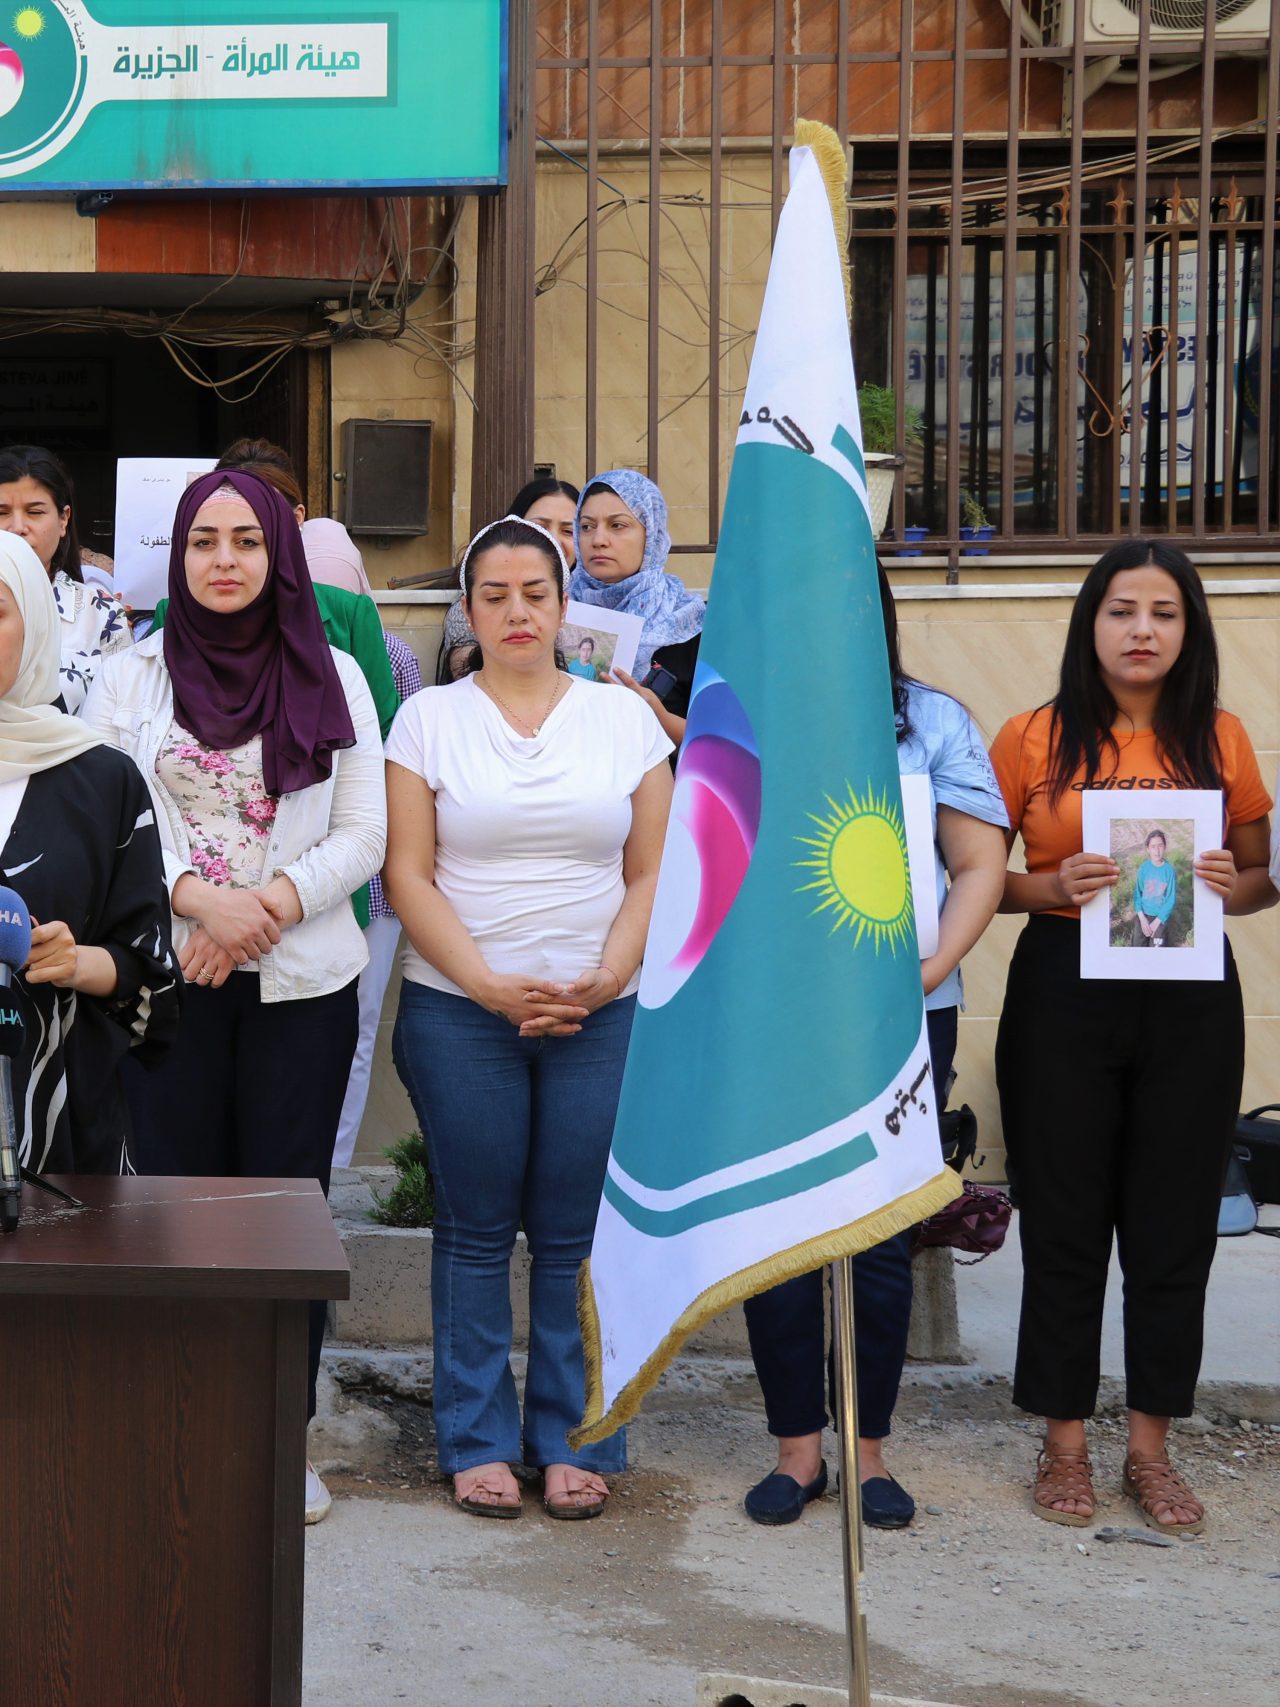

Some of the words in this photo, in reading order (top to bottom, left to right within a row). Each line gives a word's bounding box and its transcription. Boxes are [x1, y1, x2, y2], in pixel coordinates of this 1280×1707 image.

[112, 44, 198, 80] الجزيرة
[221, 36, 288, 78] المرأة
[295, 43, 361, 78] هيئة
[140, 534, 172, 549] لطفولة
